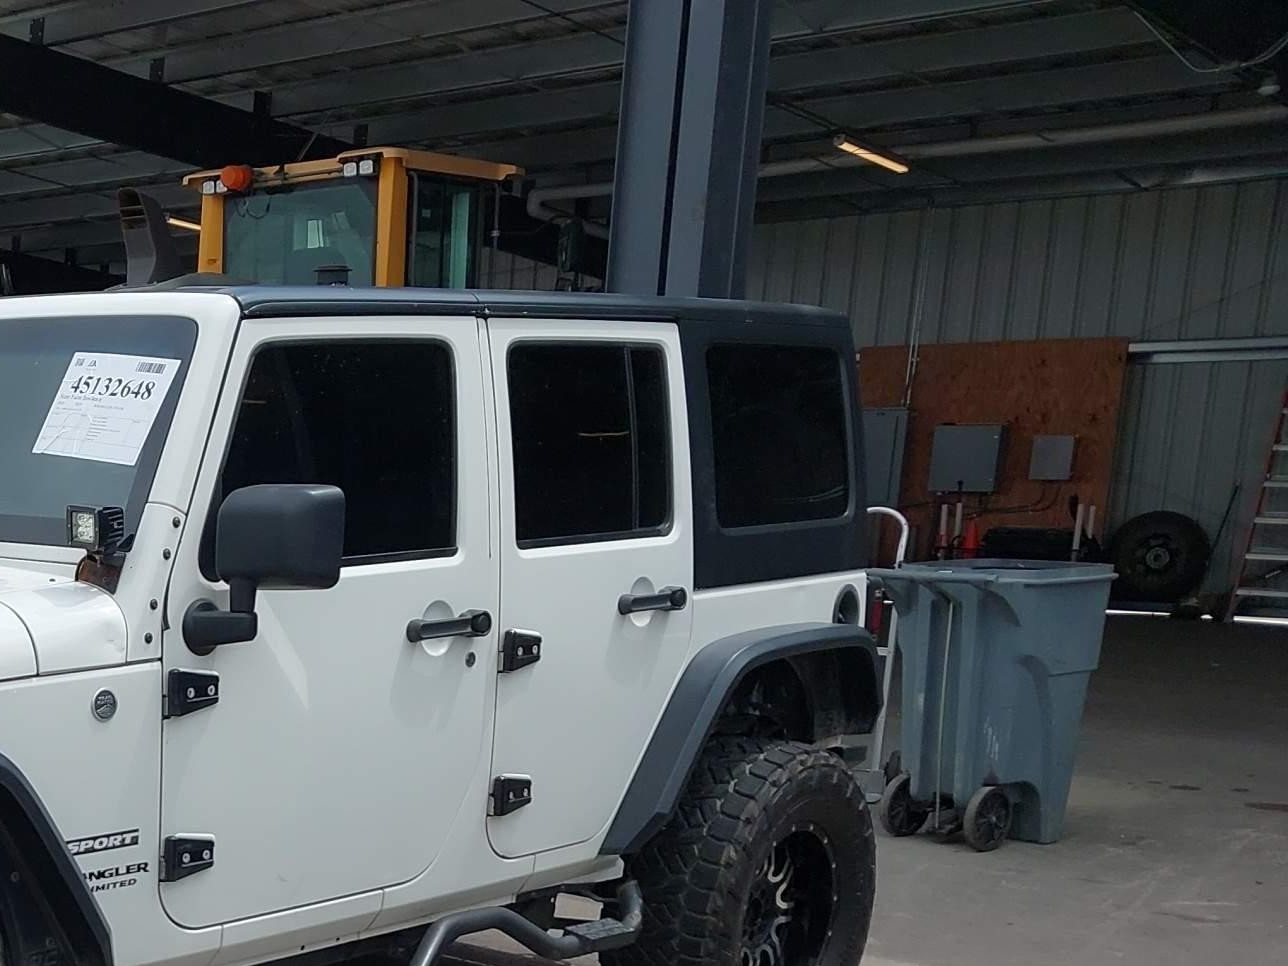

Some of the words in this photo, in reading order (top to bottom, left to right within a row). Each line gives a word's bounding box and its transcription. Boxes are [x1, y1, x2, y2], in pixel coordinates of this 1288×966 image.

[69, 374, 156, 401] 45132648
[67, 832, 138, 854] SPORT
[82, 862, 150, 882] NGLER
[90, 878, 137, 892] IMITED
